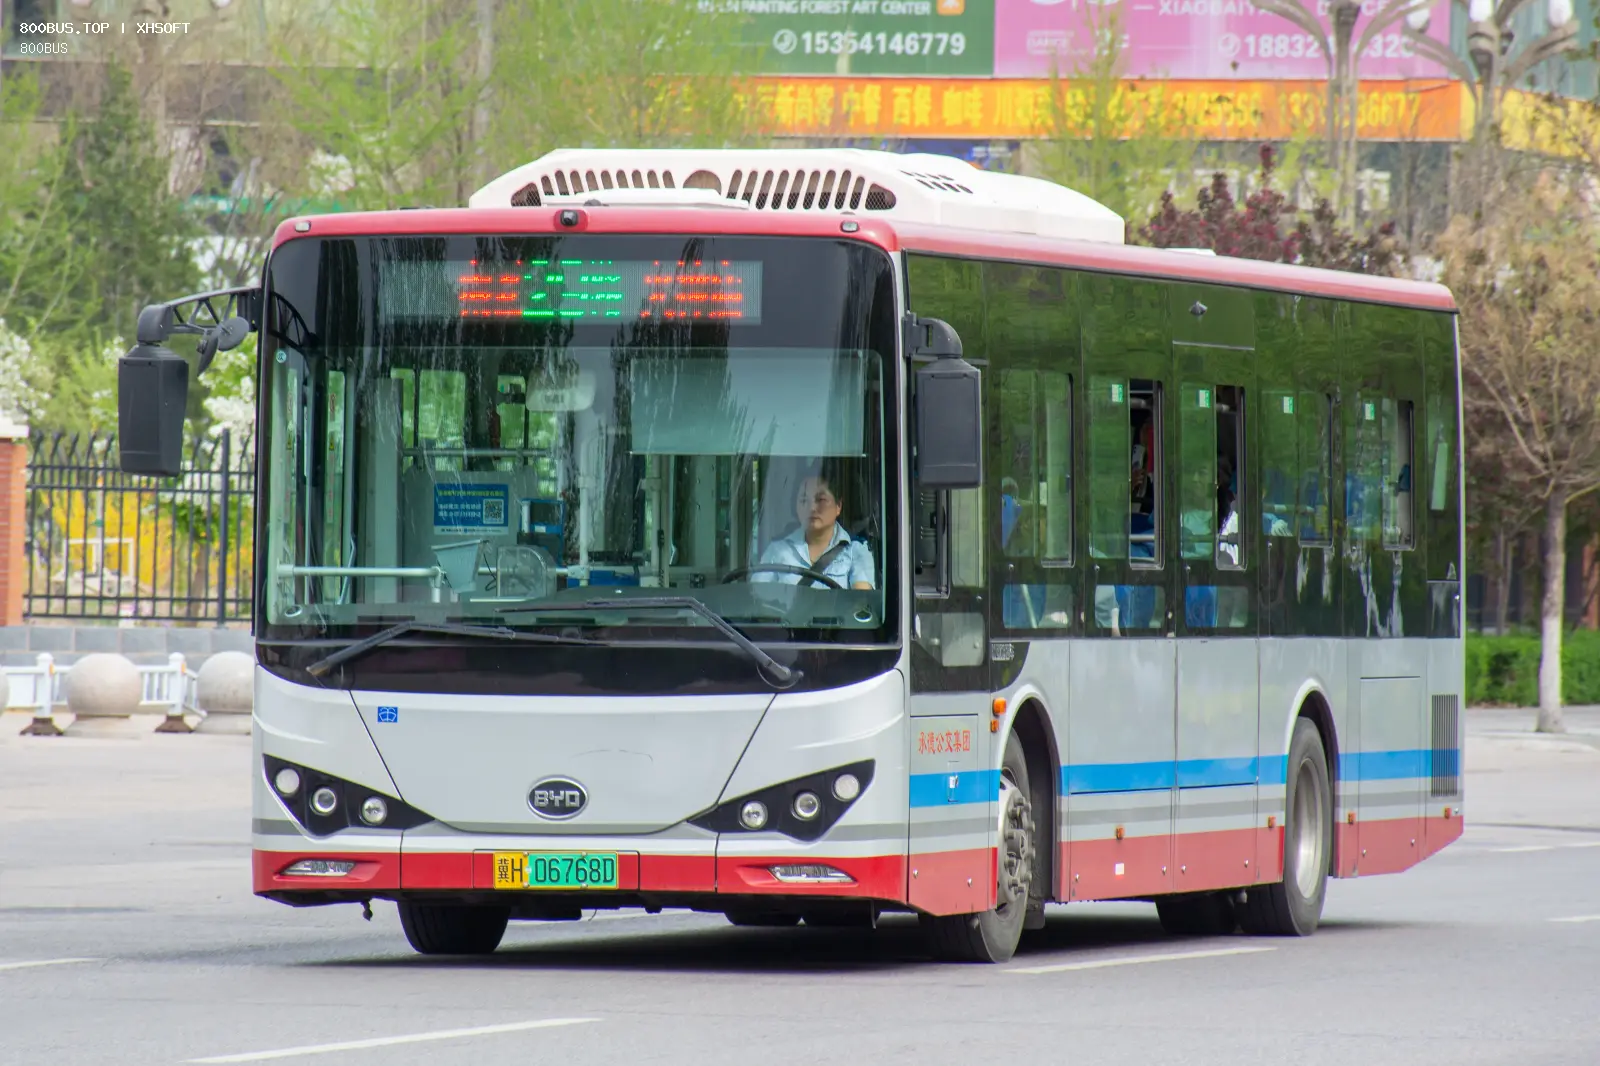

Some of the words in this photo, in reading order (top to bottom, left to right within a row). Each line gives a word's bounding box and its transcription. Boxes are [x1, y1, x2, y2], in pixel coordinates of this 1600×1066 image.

[801, 1, 848, 14] FOREST
[851, 1, 877, 14] ART
[881, 1, 931, 15] CENTER
[801, 31, 966, 55] 15354146779
[918, 729, 971, 755] 承德公交集团
[534, 790, 580, 807] BYD
